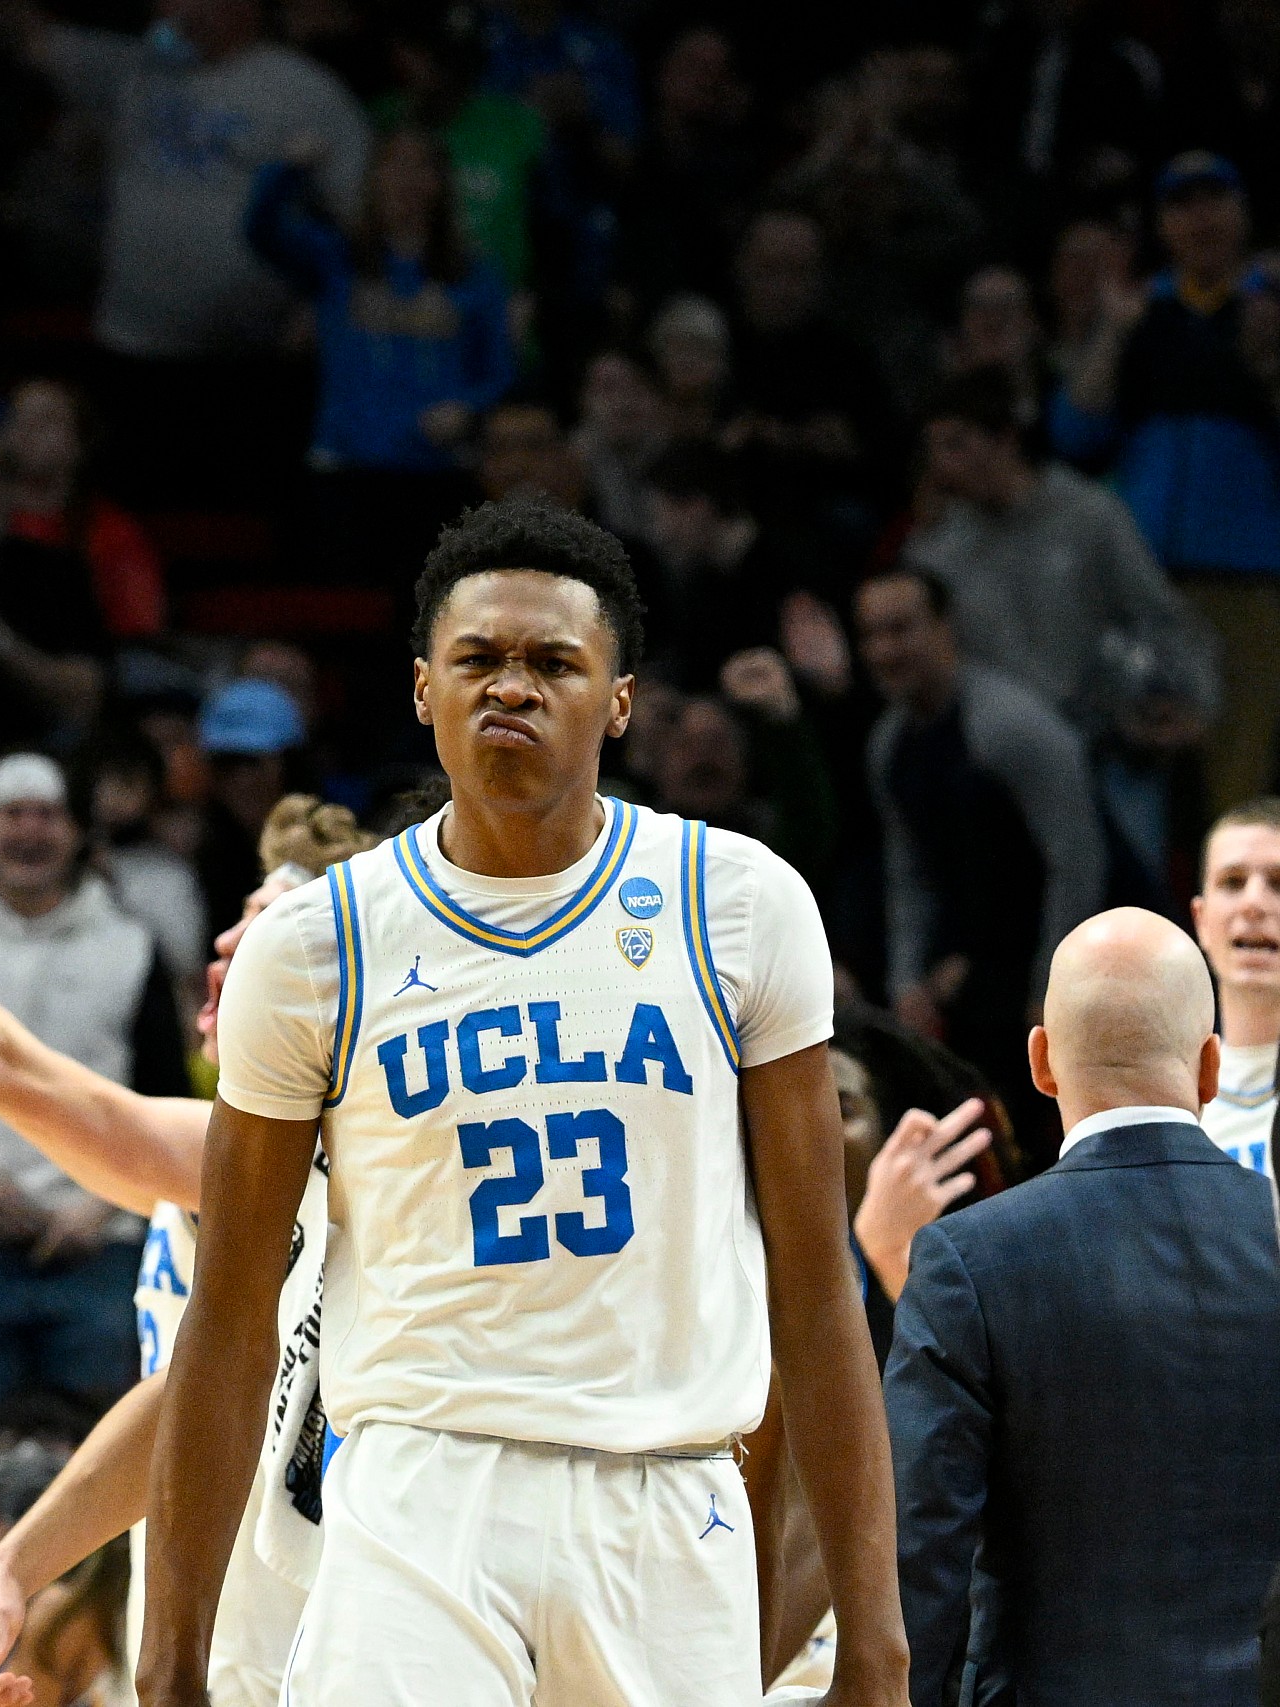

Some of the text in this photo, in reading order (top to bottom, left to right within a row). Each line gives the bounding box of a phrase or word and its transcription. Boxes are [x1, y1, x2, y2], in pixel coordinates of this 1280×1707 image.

[627, 894, 661, 907] NCAA
[620, 929, 652, 951] PAC
[628, 944, 646, 959] 12
[376, 1000, 694, 1119] UCLA
[456, 1108, 635, 1267] 23
